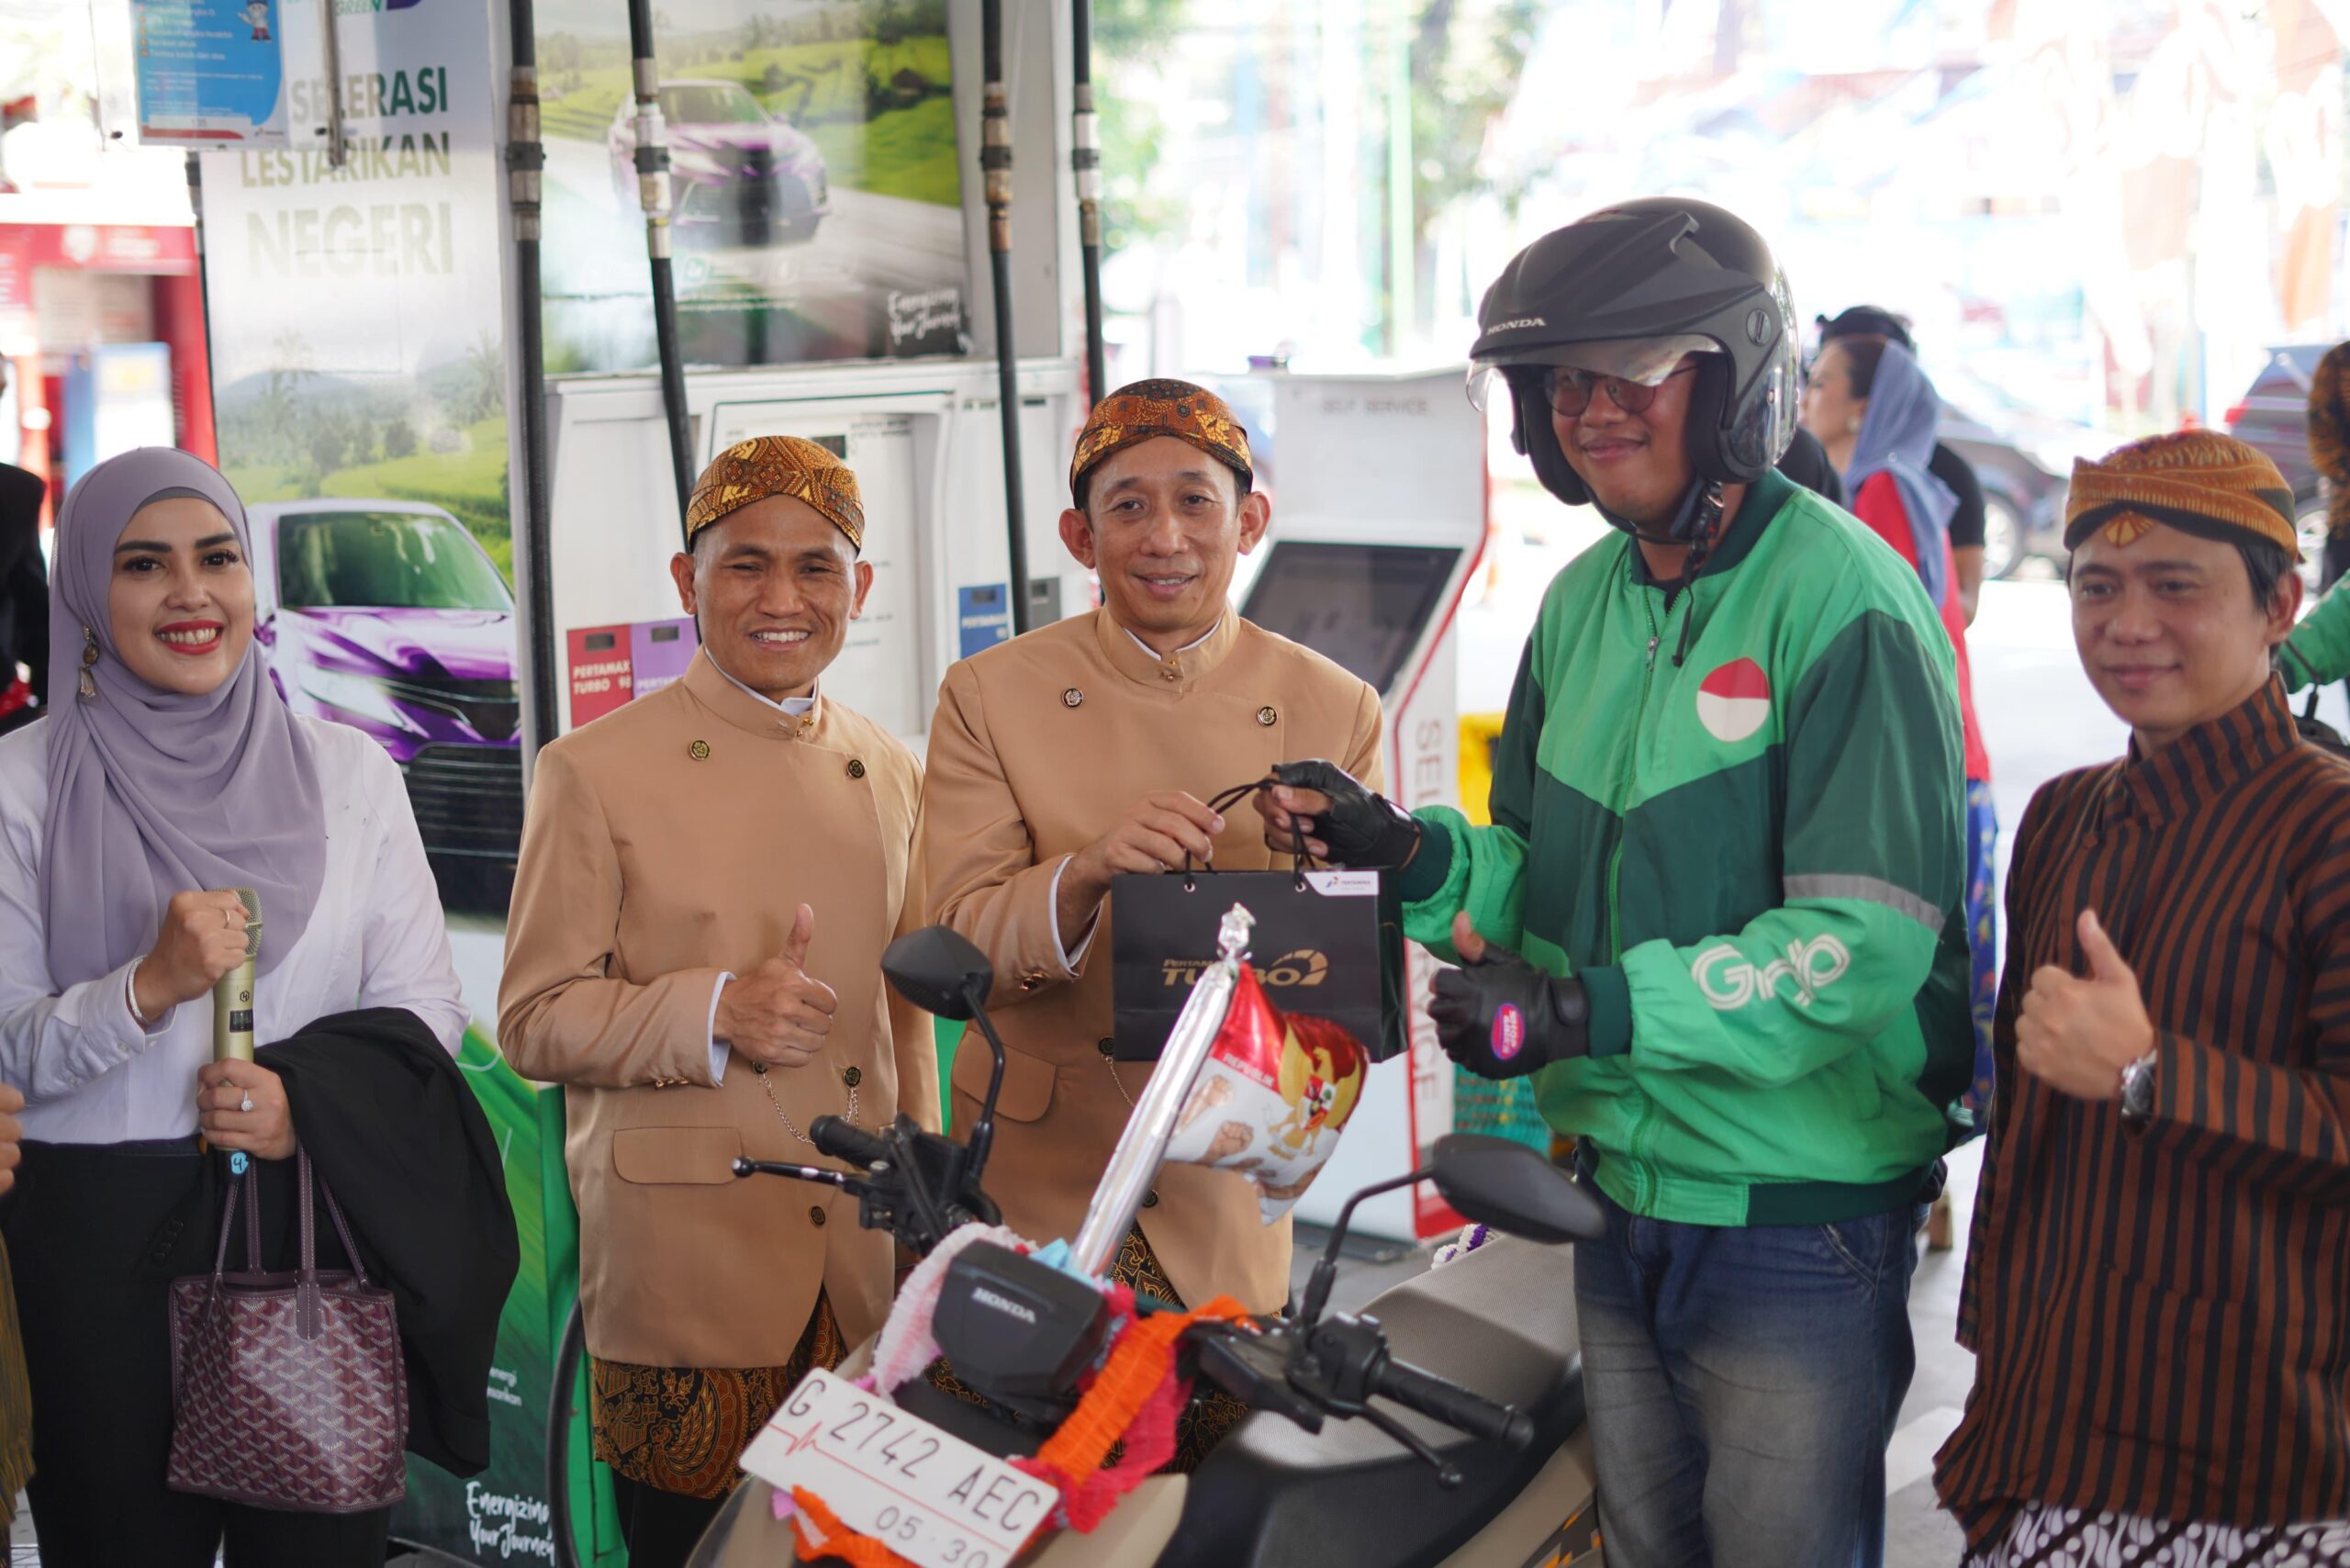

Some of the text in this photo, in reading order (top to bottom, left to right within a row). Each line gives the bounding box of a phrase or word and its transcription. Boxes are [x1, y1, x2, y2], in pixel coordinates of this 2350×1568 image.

[290, 65, 448, 126] SEERASI
[241, 131, 452, 187] LESTARIKAN
[246, 200, 453, 280] NEGERI
[1486, 317, 1546, 336] HONDA
[573, 660, 631, 679] PERTAMAX
[573, 678, 610, 695] TURBO
[972, 1286, 1036, 1325] HONDA
[788, 1379, 1041, 1532] G 2742 AEC
[466, 1480, 553, 1540] Energizing
[469, 1518, 555, 1568] Your Journey
